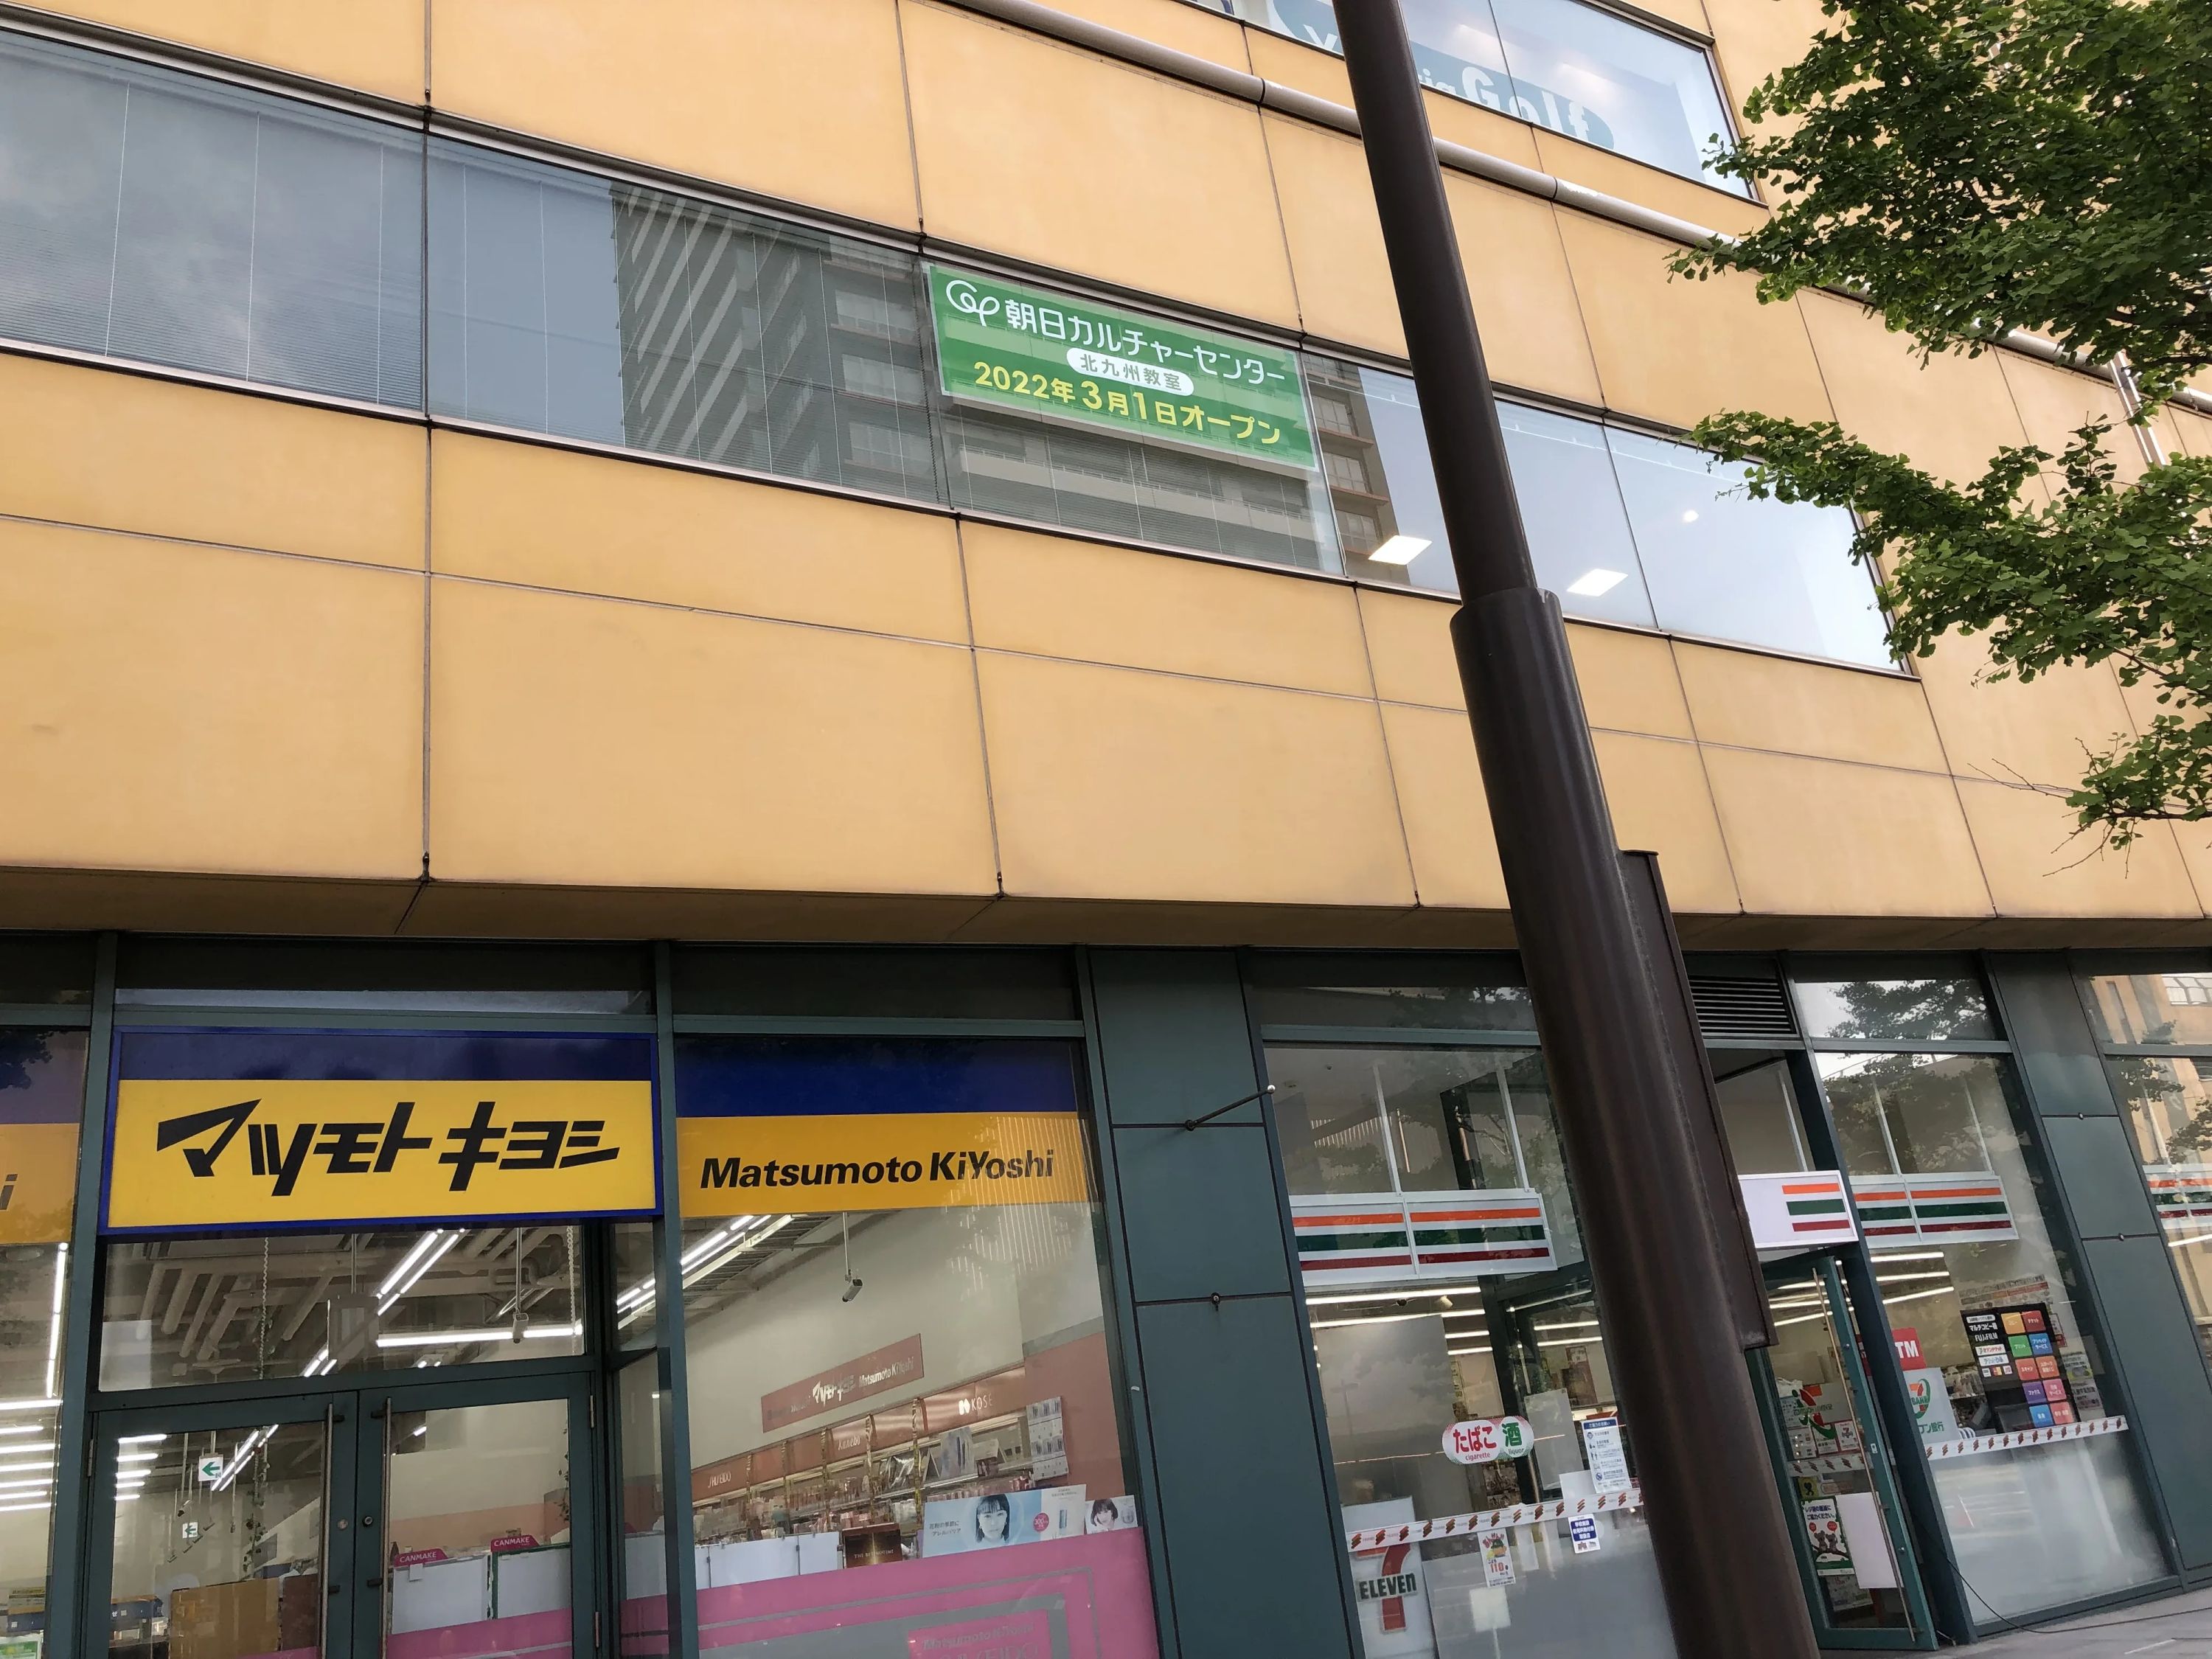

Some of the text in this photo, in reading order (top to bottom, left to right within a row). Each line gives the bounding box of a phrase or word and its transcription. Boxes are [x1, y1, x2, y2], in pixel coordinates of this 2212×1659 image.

[1005, 298, 1286, 386] 朝日カルチャーセンター
[1079, 353, 1183, 392] 北九州教室
[973, 361, 1281, 445] 2022年3月1日オープン
[156, 1098, 620, 1197] マツモトキヨシ
[700, 1148, 1054, 1189] Matsumoto KiYoshi
[1894, 1340, 1920, 1359] TM
[1453, 1422, 1523, 1454] たばこ 酒
[1465, 1447, 1525, 1461] cigarette liquor
[399, 1551, 437, 1563] CANMAKE
[493, 1536, 531, 1548] CANMAKE
